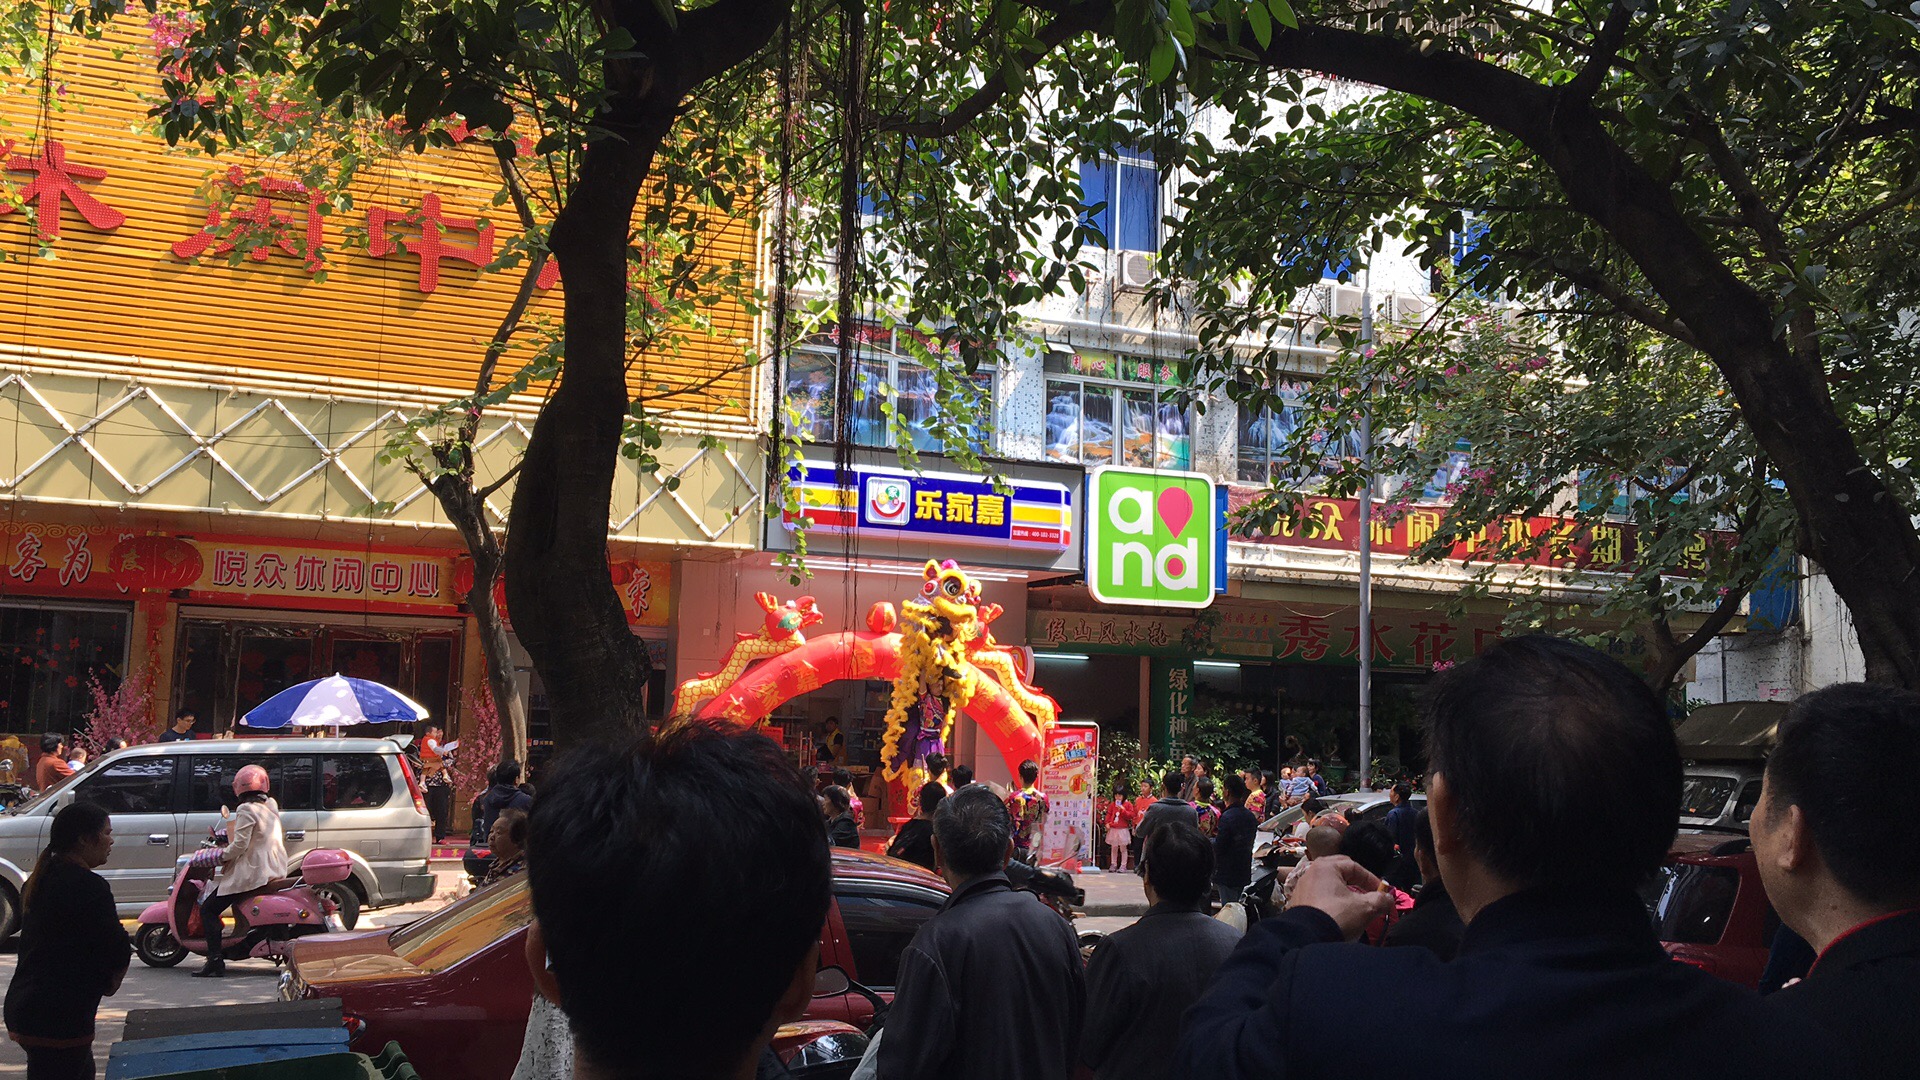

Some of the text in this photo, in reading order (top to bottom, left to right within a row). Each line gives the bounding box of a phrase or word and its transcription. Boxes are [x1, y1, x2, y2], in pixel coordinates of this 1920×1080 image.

[1072, 354, 1174, 380] 用心服务
[914, 489, 1006, 526] 乐家嘉
[212, 549, 441, 598] 悦众休闲中心
[627, 568, 652, 618] 荣
[1045, 617, 1171, 648] 假山风水轮
[1167, 666, 1190, 763] 绿化种苗
